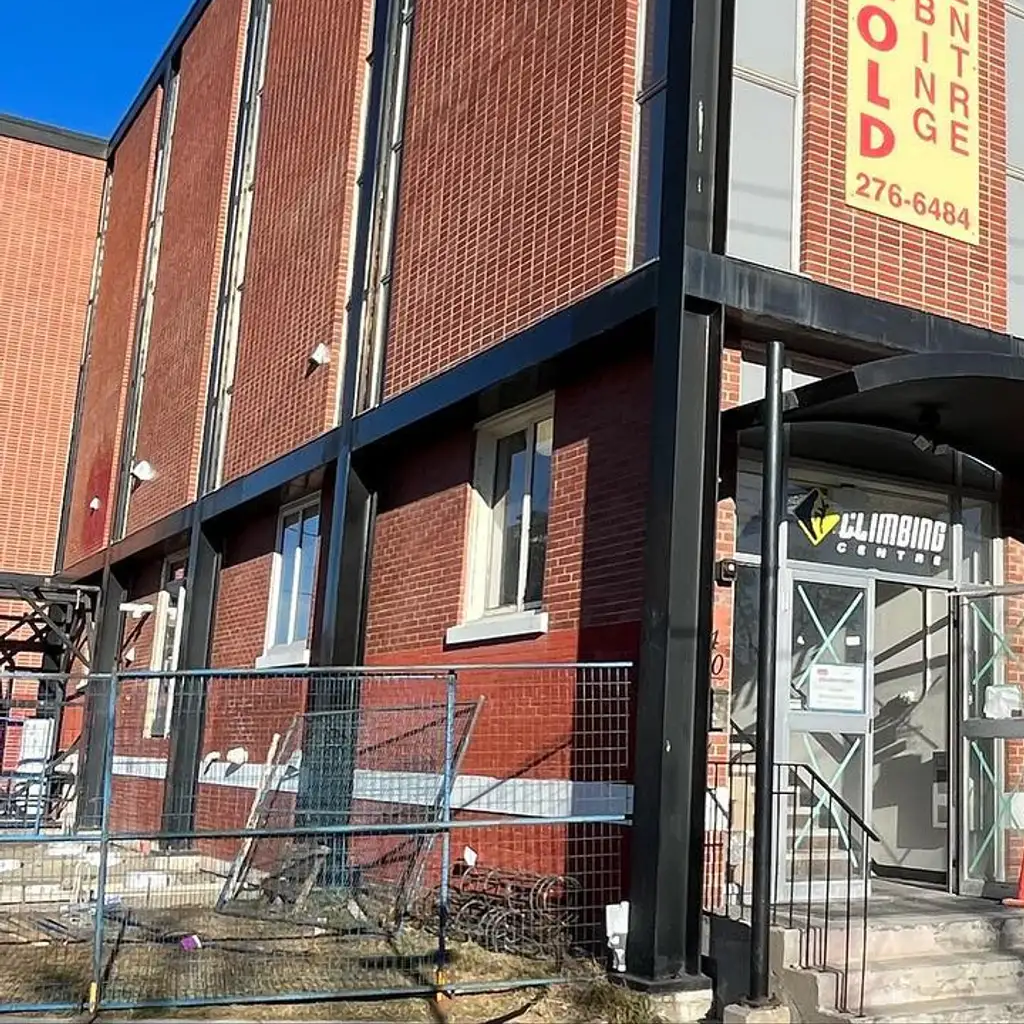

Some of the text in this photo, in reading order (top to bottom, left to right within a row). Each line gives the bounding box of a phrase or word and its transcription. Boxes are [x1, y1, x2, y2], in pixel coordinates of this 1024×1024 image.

[856, 172, 970, 230] 276-6484
[838, 512, 947, 552] CLIMBING
[836, 542, 942, 566] CENTRE
